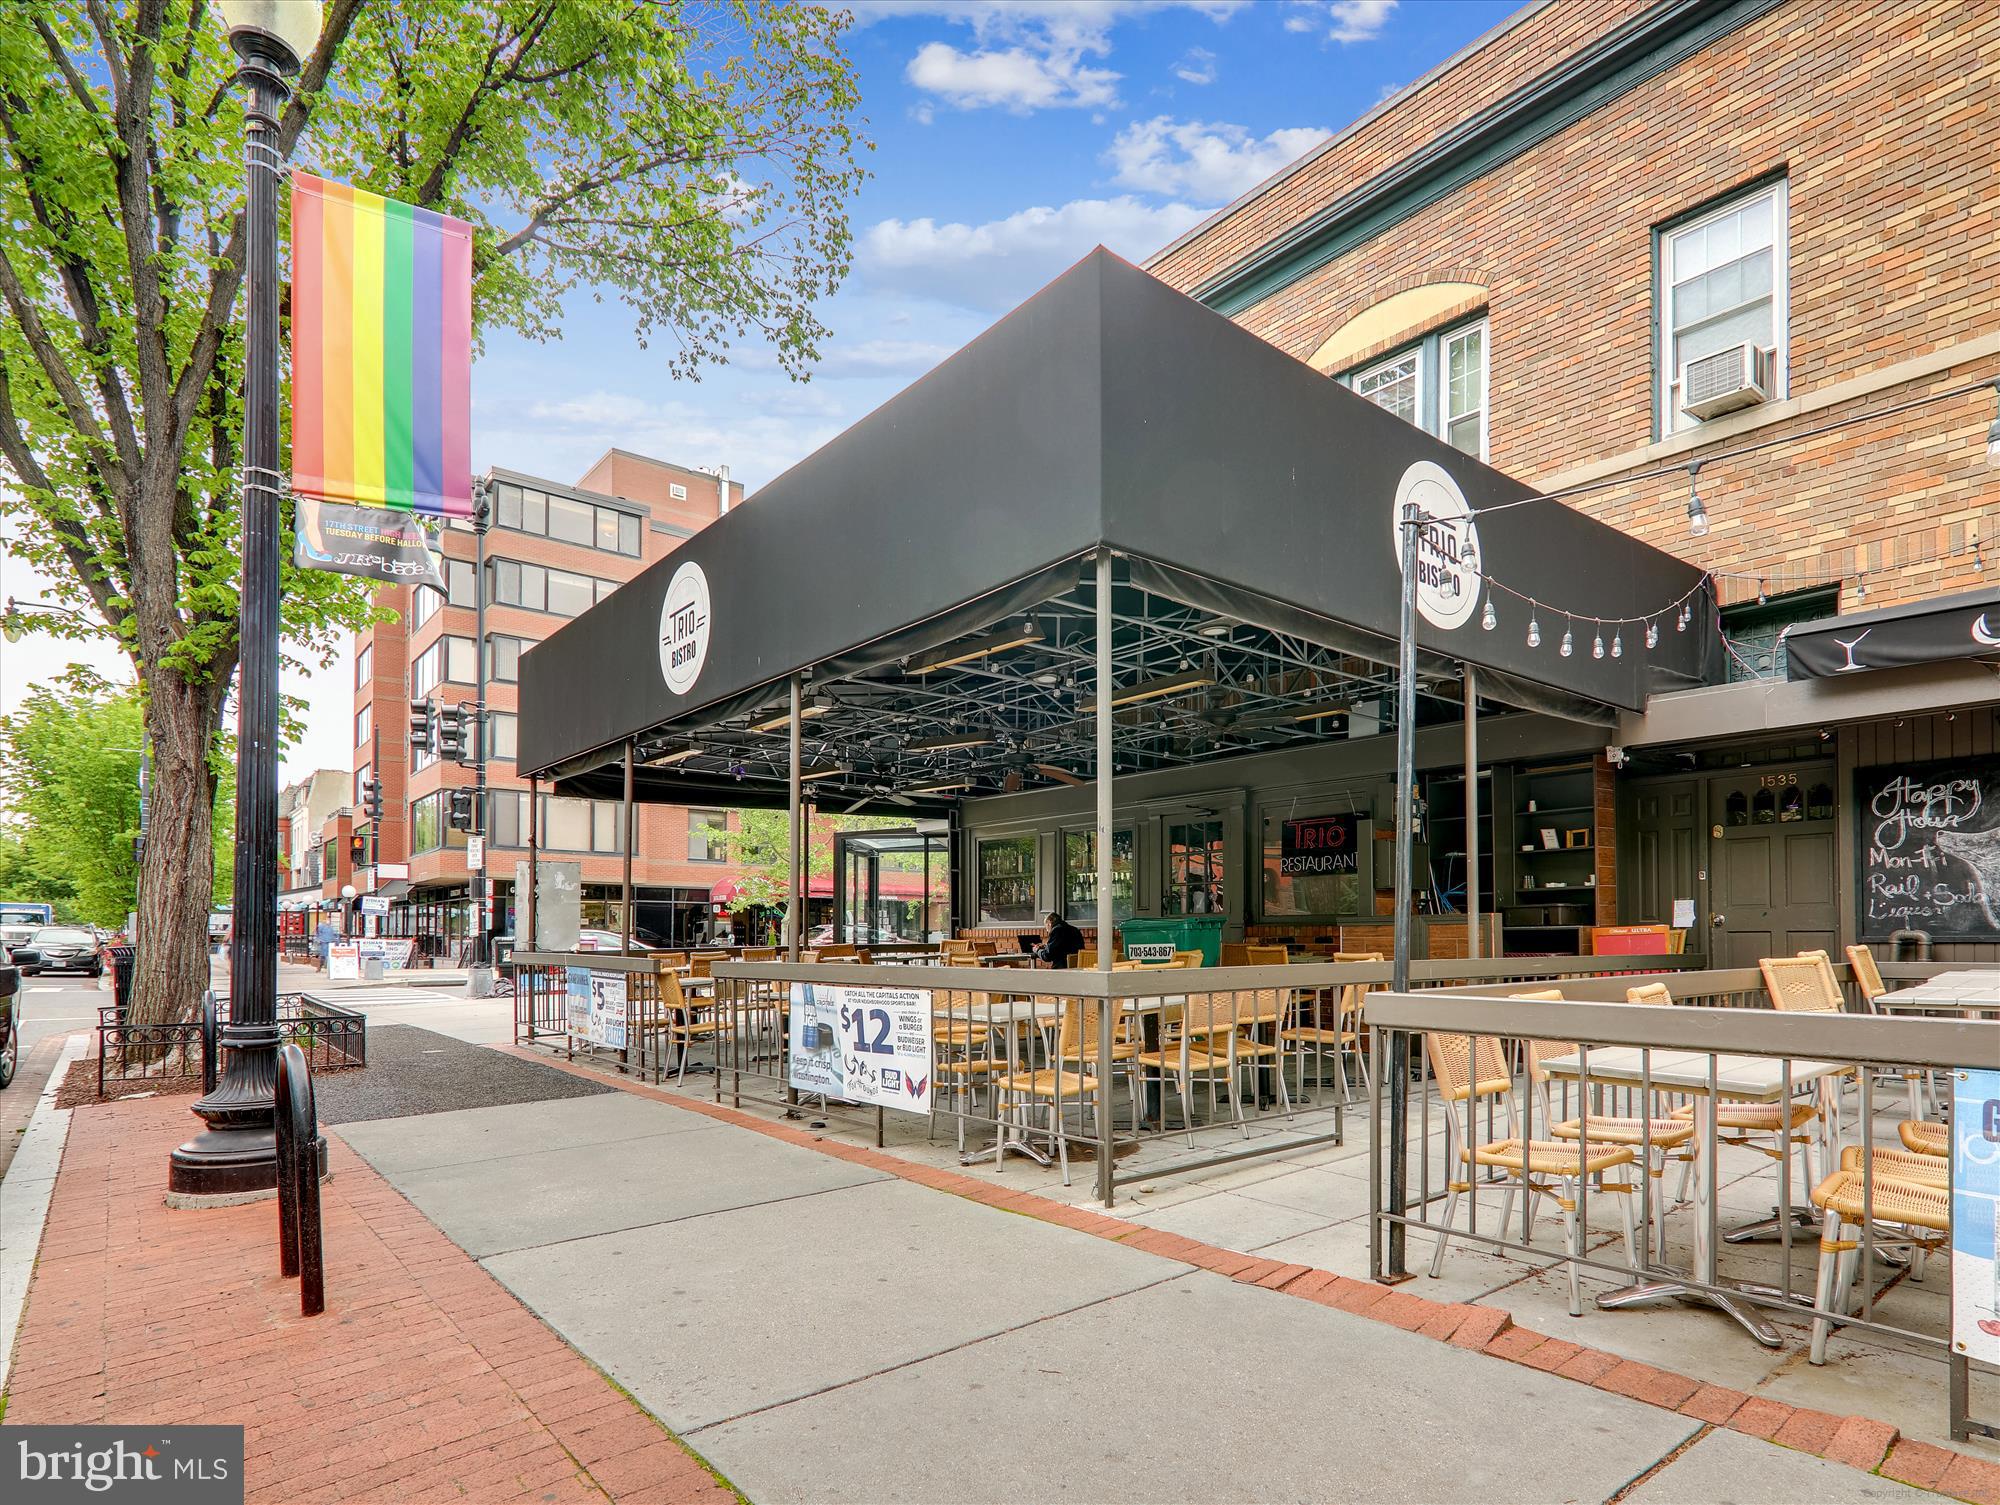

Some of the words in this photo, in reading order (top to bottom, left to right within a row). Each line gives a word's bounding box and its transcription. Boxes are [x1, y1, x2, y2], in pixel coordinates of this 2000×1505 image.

[325, 520, 345, 529] 17TH
[347, 523, 378, 534] STREET
[325, 527, 363, 539] TUESDAY
[364, 533, 396, 545] BEFORE
[1419, 561, 1460, 597] BISO
[669, 600, 695, 643] TRIO
[671, 640, 696, 669] BISTRO
[1760, 773, 1798, 787] 1535
[1872, 775, 1982, 822] Happy
[1287, 818, 1344, 848] TRIO
[1874, 809, 1959, 850] Hour
[592, 979, 605, 1010] $5
[841, 1004, 894, 1055] $12
[898, 1036, 925, 1045] BUDWEISER
[883, 1078, 899, 1088] LIGHT
[885, 1071, 897, 1079] BUD
